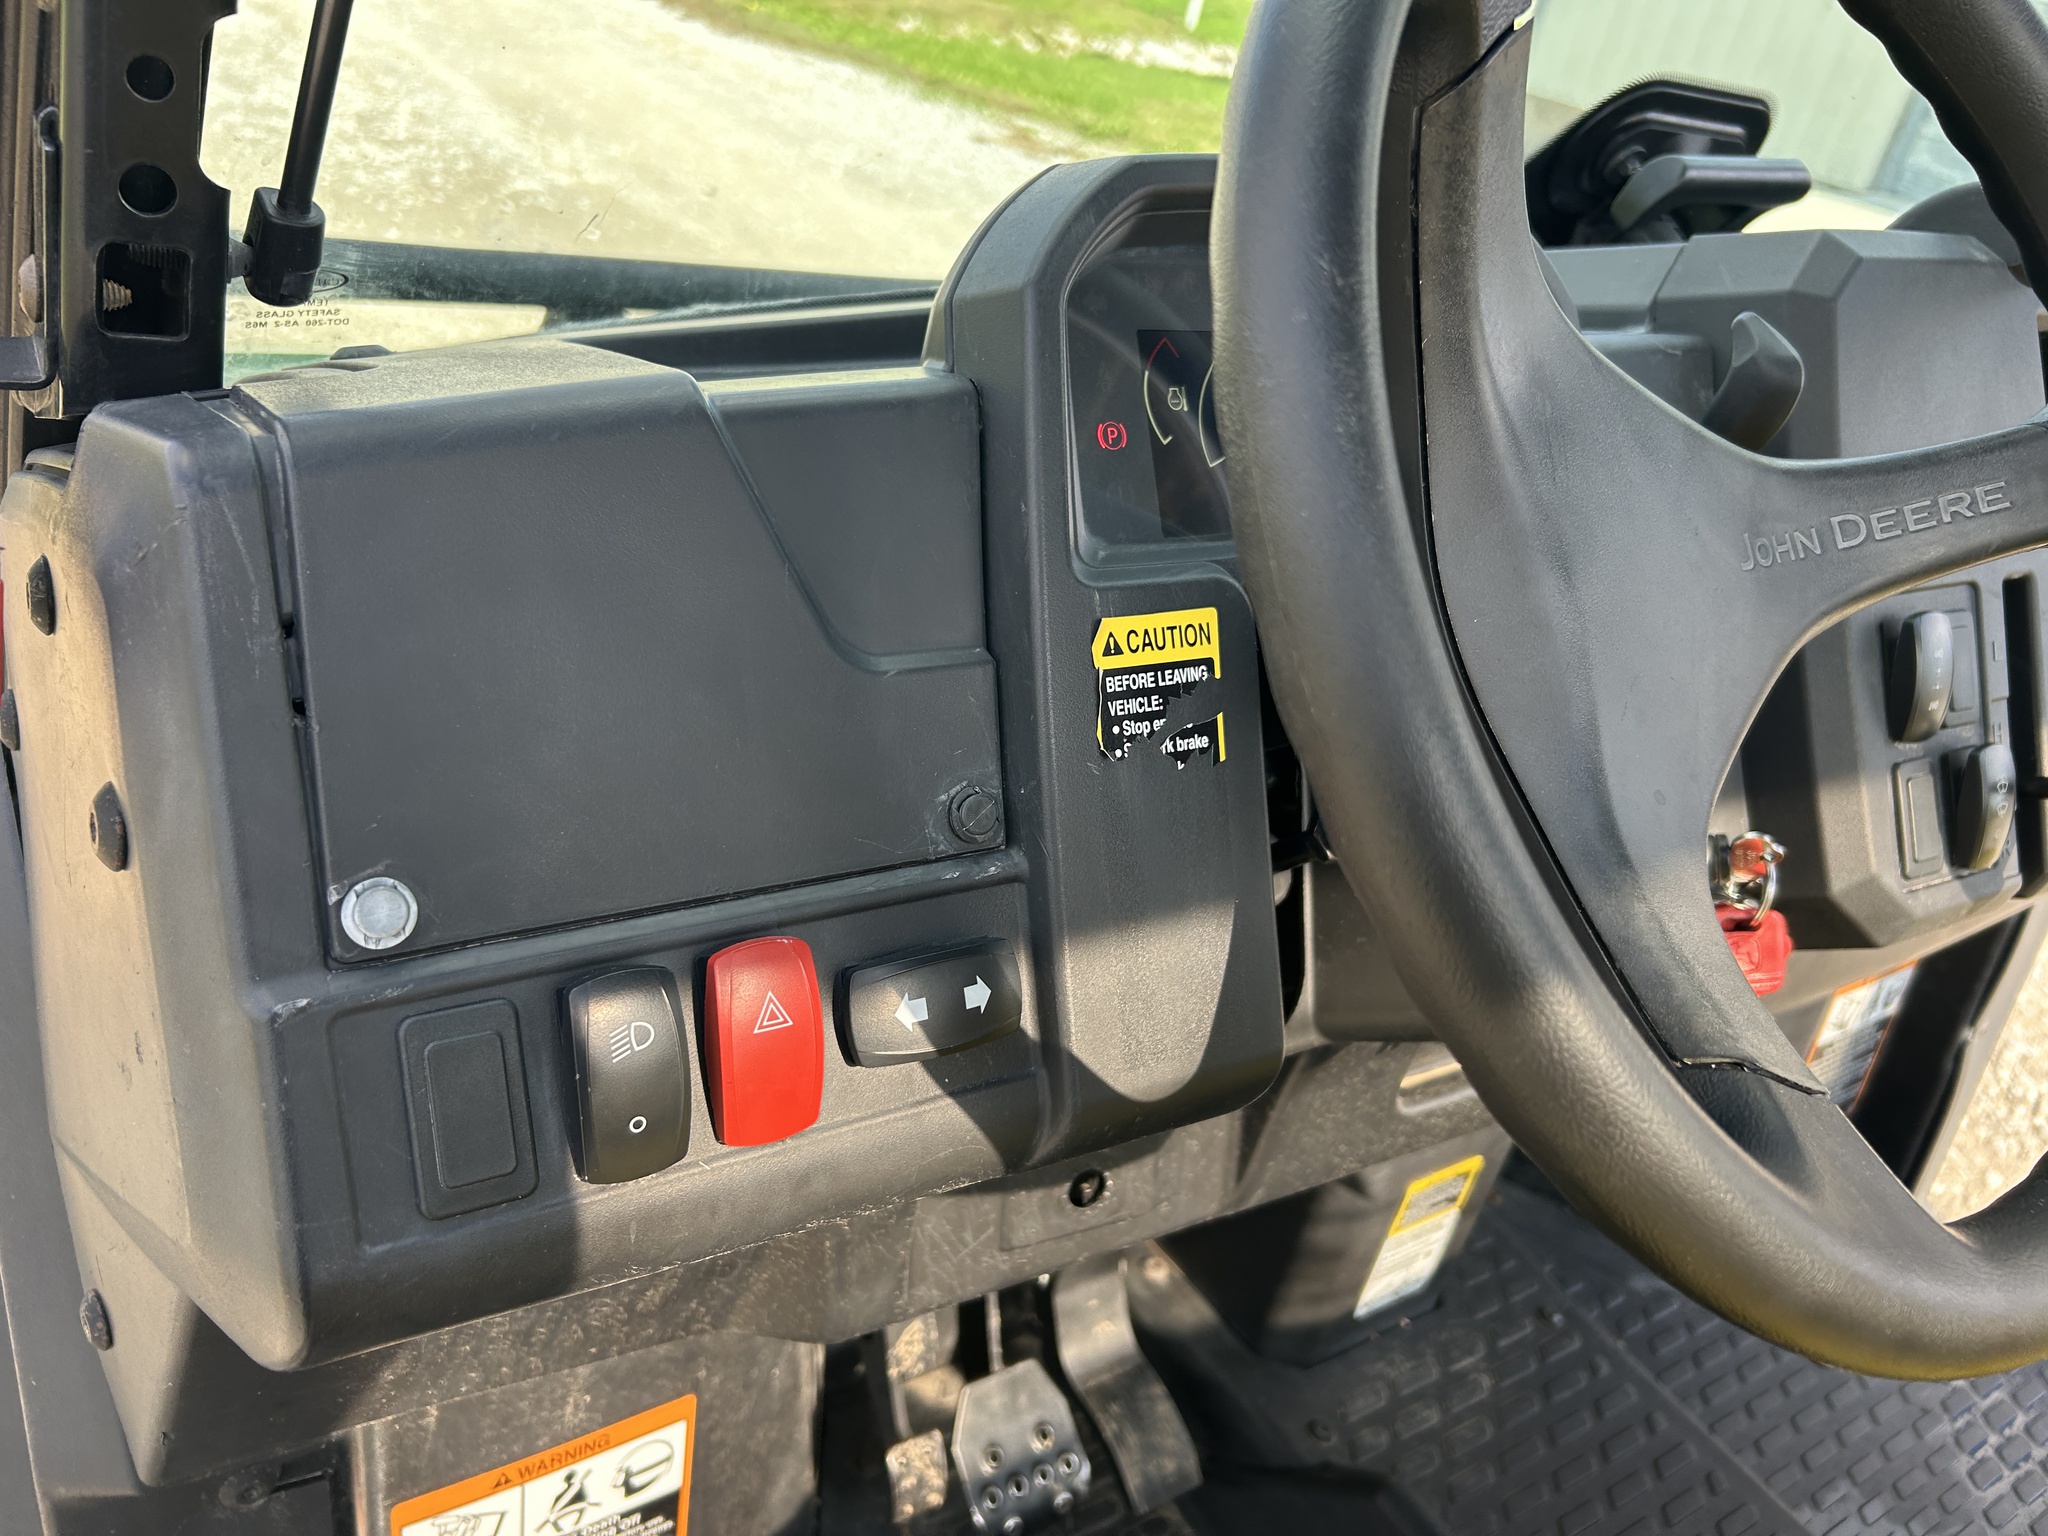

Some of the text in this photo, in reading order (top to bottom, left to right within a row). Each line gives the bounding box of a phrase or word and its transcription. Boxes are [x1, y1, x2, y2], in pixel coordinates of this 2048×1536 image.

[1740, 480, 2013, 572] JOHN DEERE
[1125, 621, 1212, 655] CAUTION
[1105, 664, 1209, 694] BEFORE LEAVING
[1107, 694, 1164, 717] VEHICLE:
[1122, 719, 1151, 738] Stop
[1175, 733, 1210, 752] brake
[518, 1433, 611, 1480] WARNING
